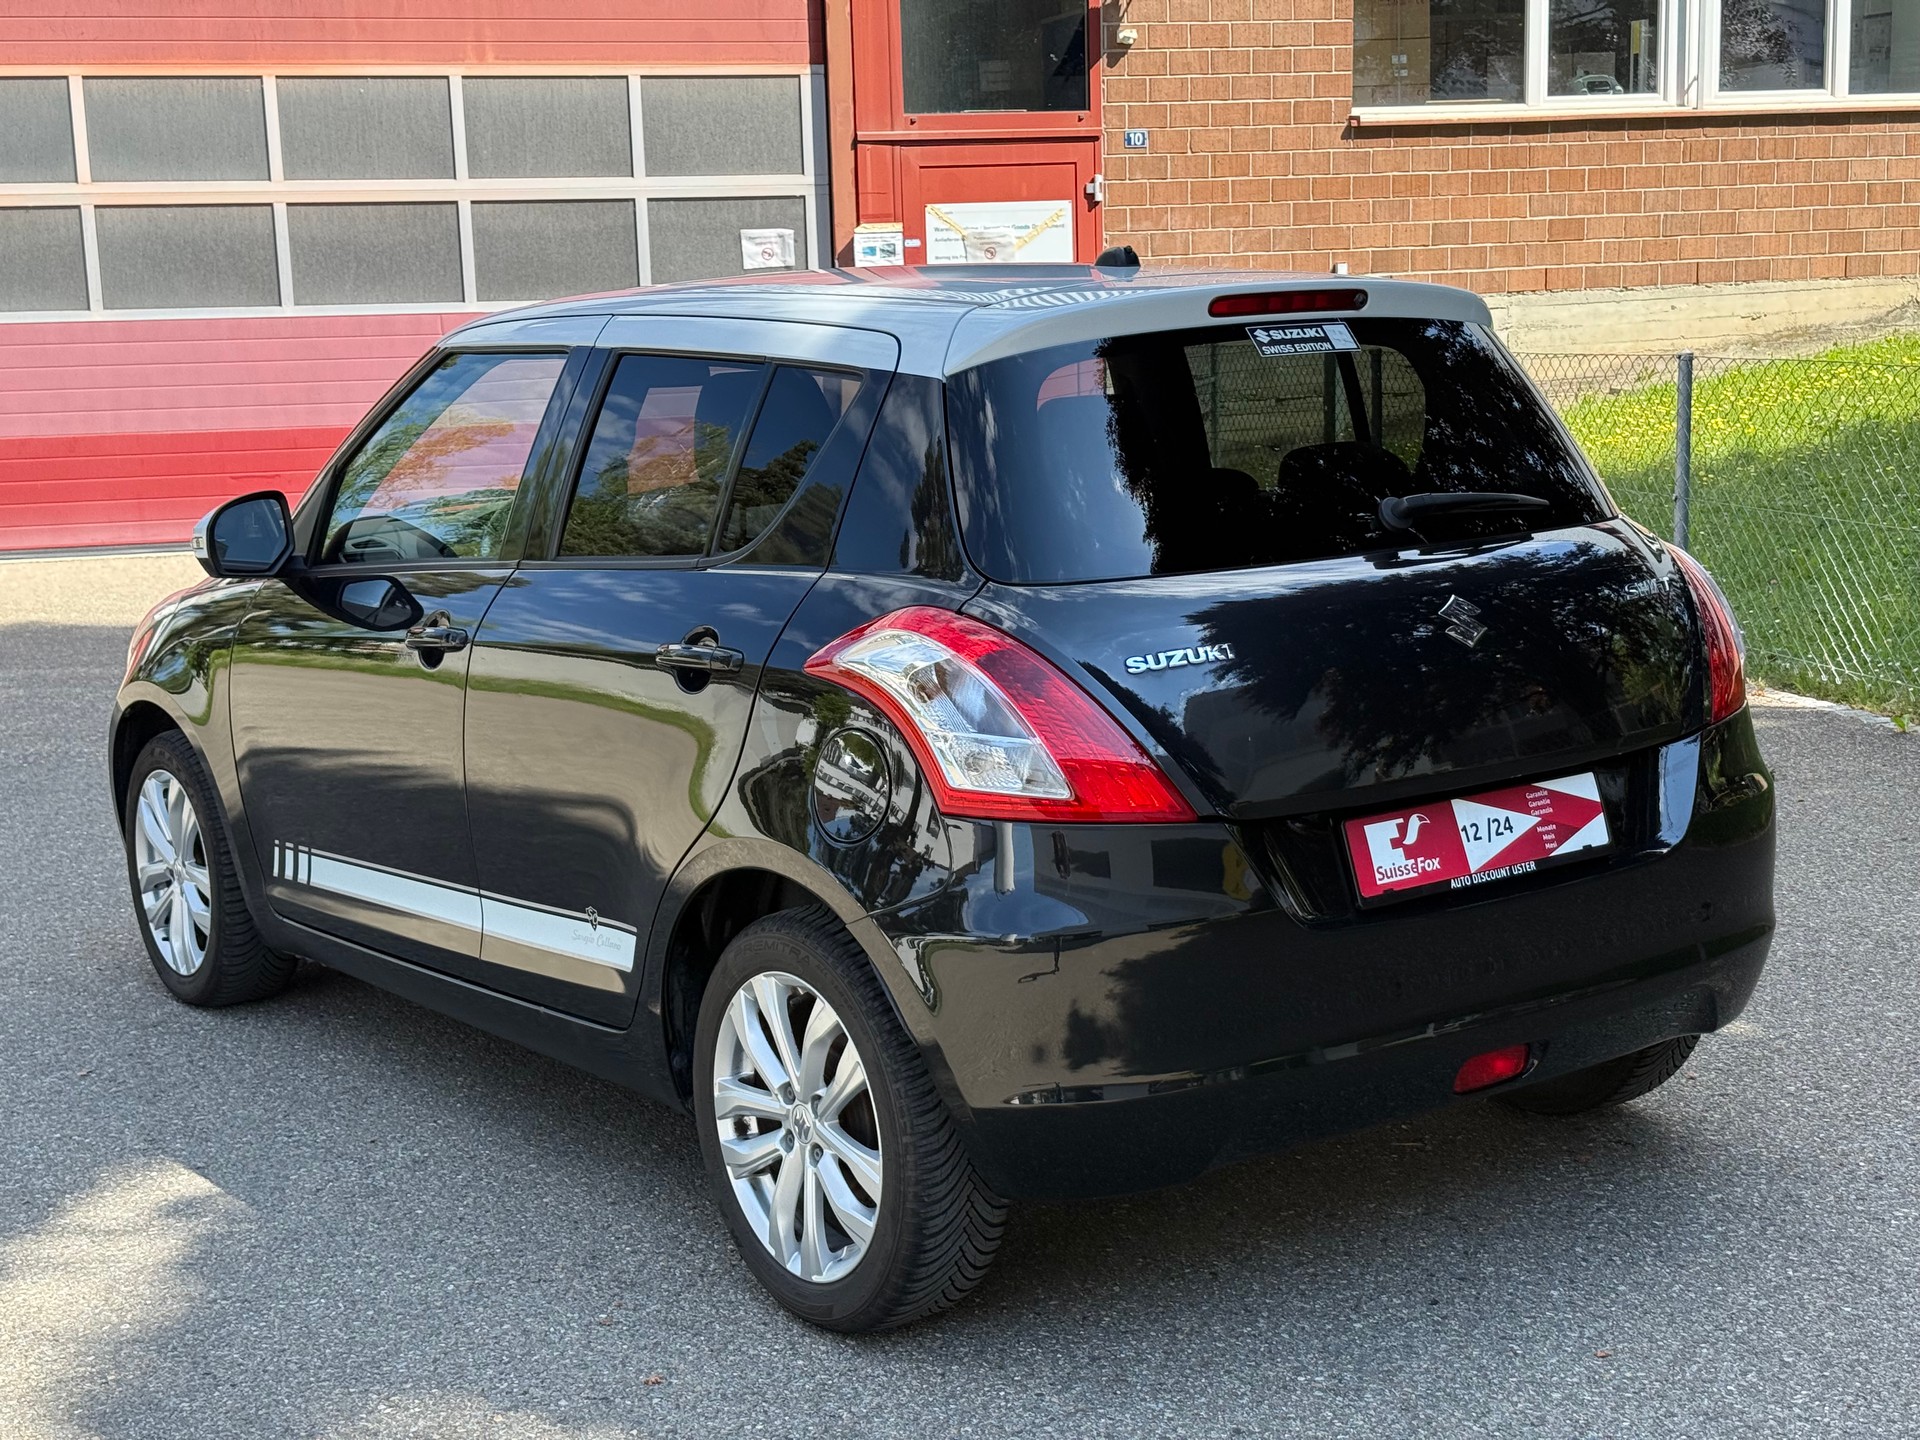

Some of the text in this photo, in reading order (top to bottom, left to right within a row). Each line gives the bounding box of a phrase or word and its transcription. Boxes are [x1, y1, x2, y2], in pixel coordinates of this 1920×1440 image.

[1129, 132, 1144, 146] 10
[1268, 327, 1325, 340] SUZUKI
[1262, 342, 1333, 355] SWISS EDITION
[1125, 642, 1236, 675] SUZUKI
[1526, 789, 1548, 799] Garantie
[1528, 798, 1551, 807] Garantie
[1460, 815, 1514, 844] 12 /24
[1536, 823, 1557, 834] Monate
[1376, 856, 1441, 882] SuisseFox
[1450, 860, 1537, 890] AUTO DISCOUNT USTER
